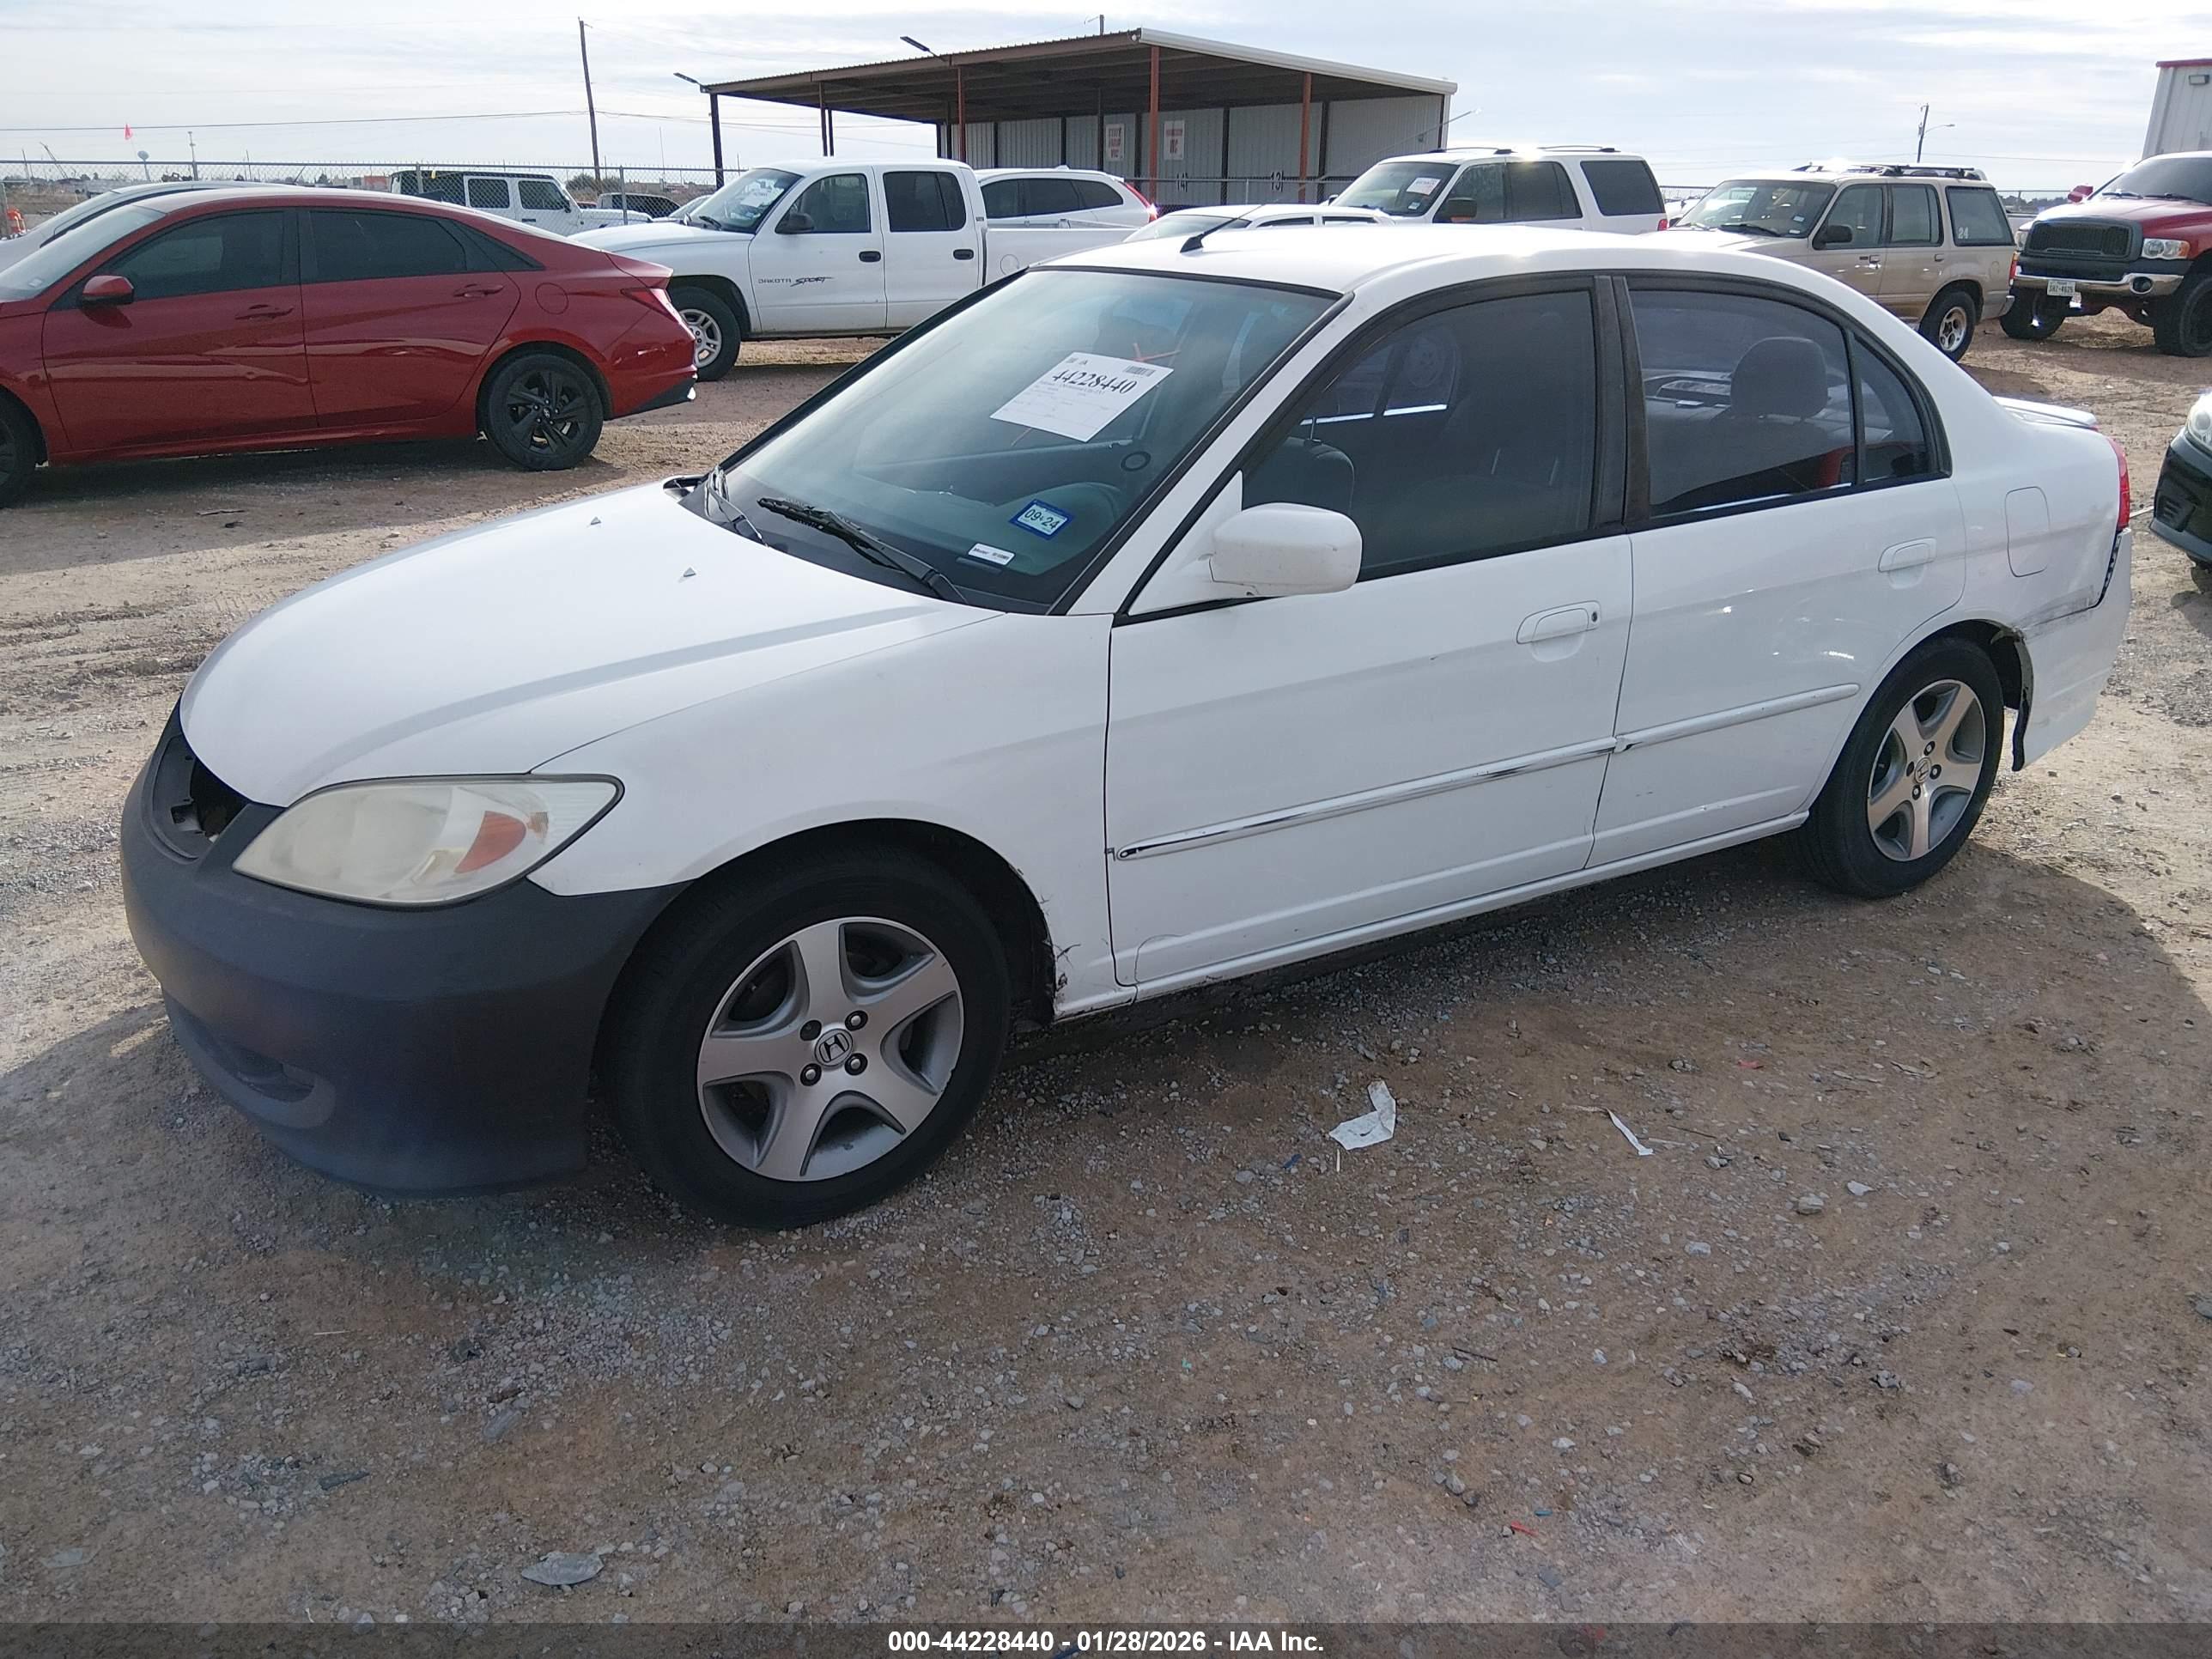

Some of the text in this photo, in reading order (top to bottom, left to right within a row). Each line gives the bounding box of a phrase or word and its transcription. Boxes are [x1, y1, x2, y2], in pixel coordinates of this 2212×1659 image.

[1052, 369, 1138, 394] 44228440
[1024, 509, 1060, 530] 09 24
